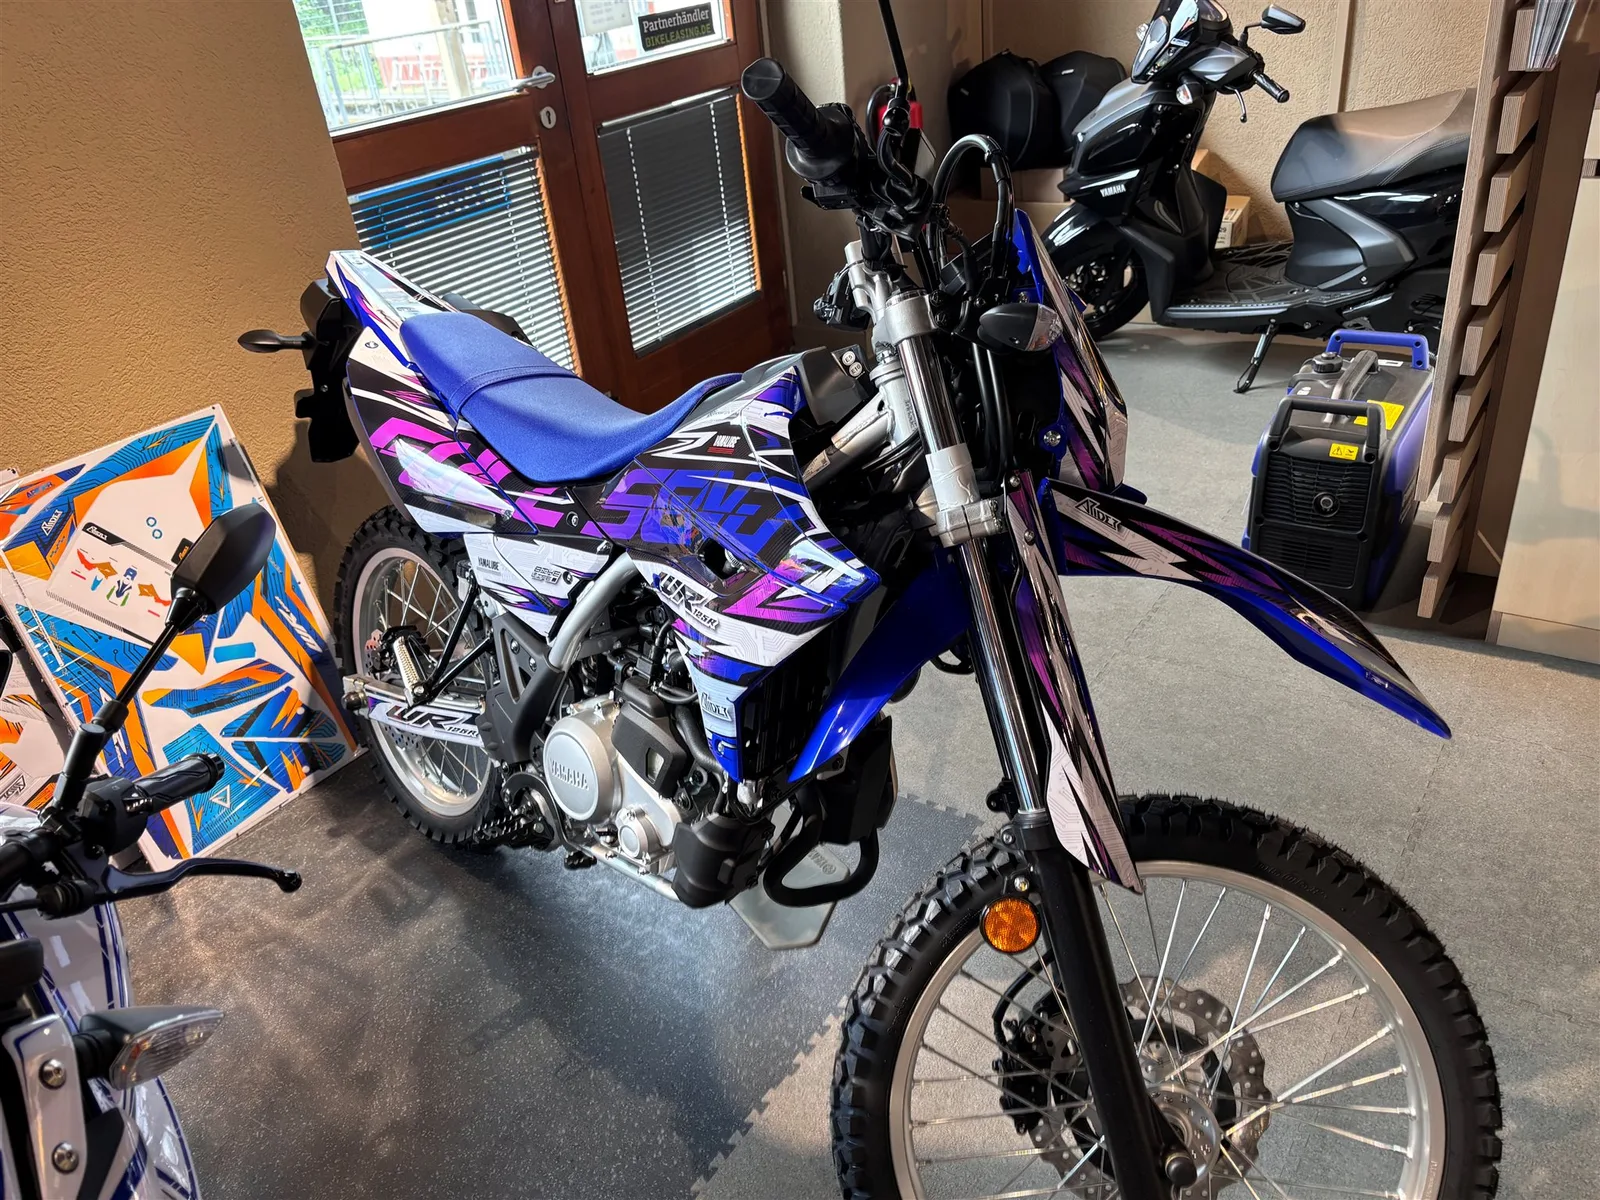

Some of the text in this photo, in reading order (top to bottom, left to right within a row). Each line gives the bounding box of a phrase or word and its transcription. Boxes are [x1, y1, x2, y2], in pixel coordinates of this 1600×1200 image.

[643, 8, 709, 33] Partnerhändler
[1100, 183, 1126, 198] YAMAHA
[550, 758, 590, 791] YAMAHA
